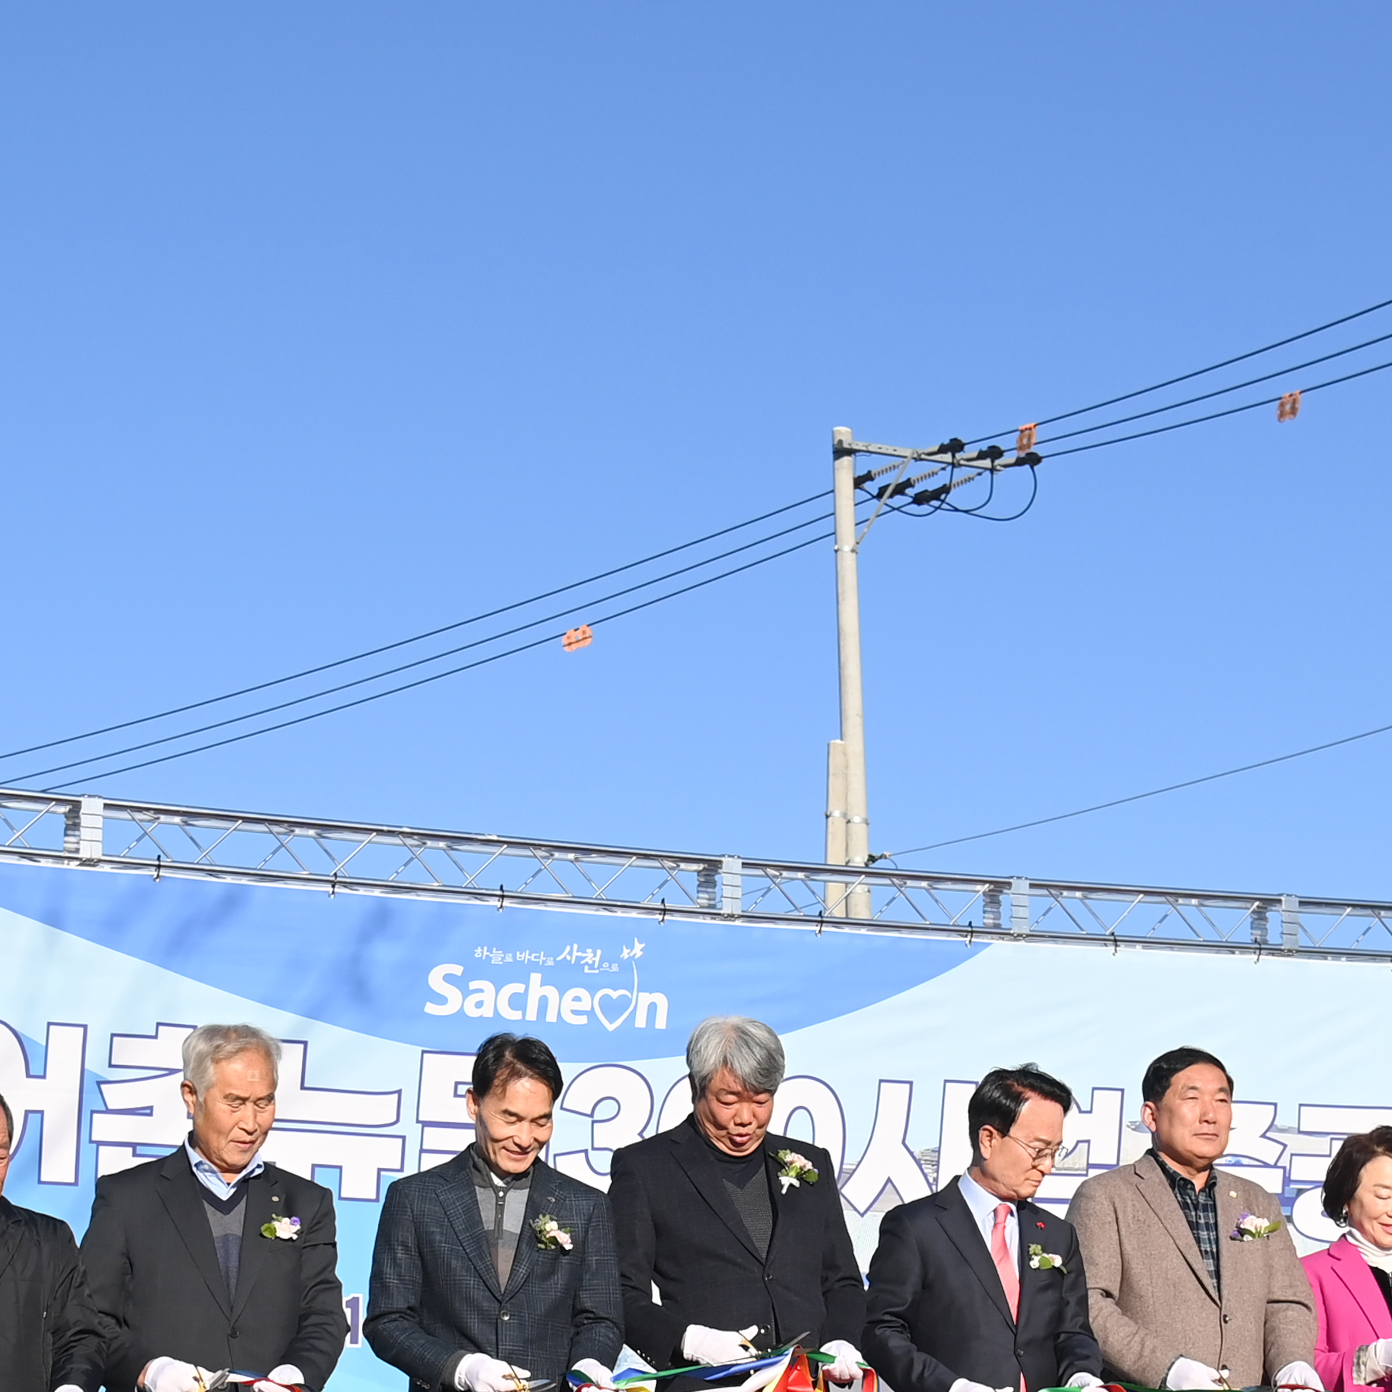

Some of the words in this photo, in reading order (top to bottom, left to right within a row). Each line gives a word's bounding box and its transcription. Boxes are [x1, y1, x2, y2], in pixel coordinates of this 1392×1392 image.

[474, 946, 513, 964] 하늘로
[516, 950, 554, 966] 바다로
[557, 943, 619, 973] 사천으로
[424, 963, 669, 1031] Sacheon
